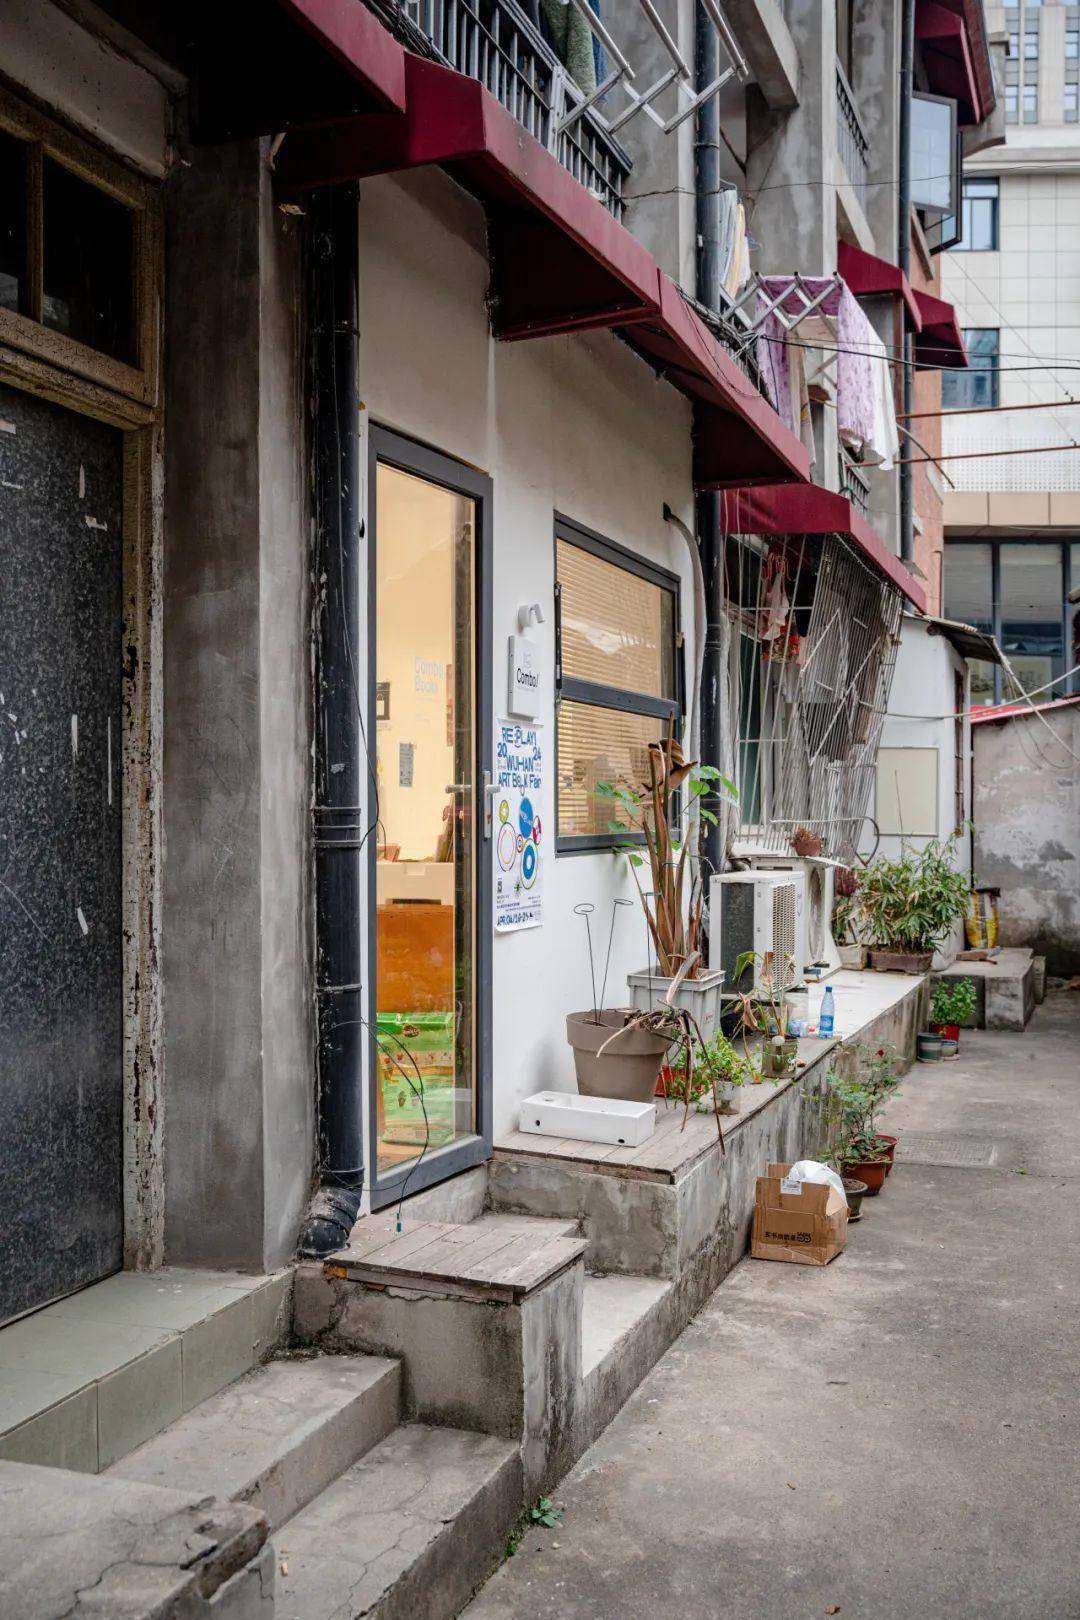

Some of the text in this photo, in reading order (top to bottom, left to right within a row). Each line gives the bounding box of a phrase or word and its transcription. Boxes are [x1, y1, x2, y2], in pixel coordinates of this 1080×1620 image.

[516, 667, 540, 688] Combo!
[506, 755, 534, 772] WUHAN
[498, 771, 511, 788] ART
